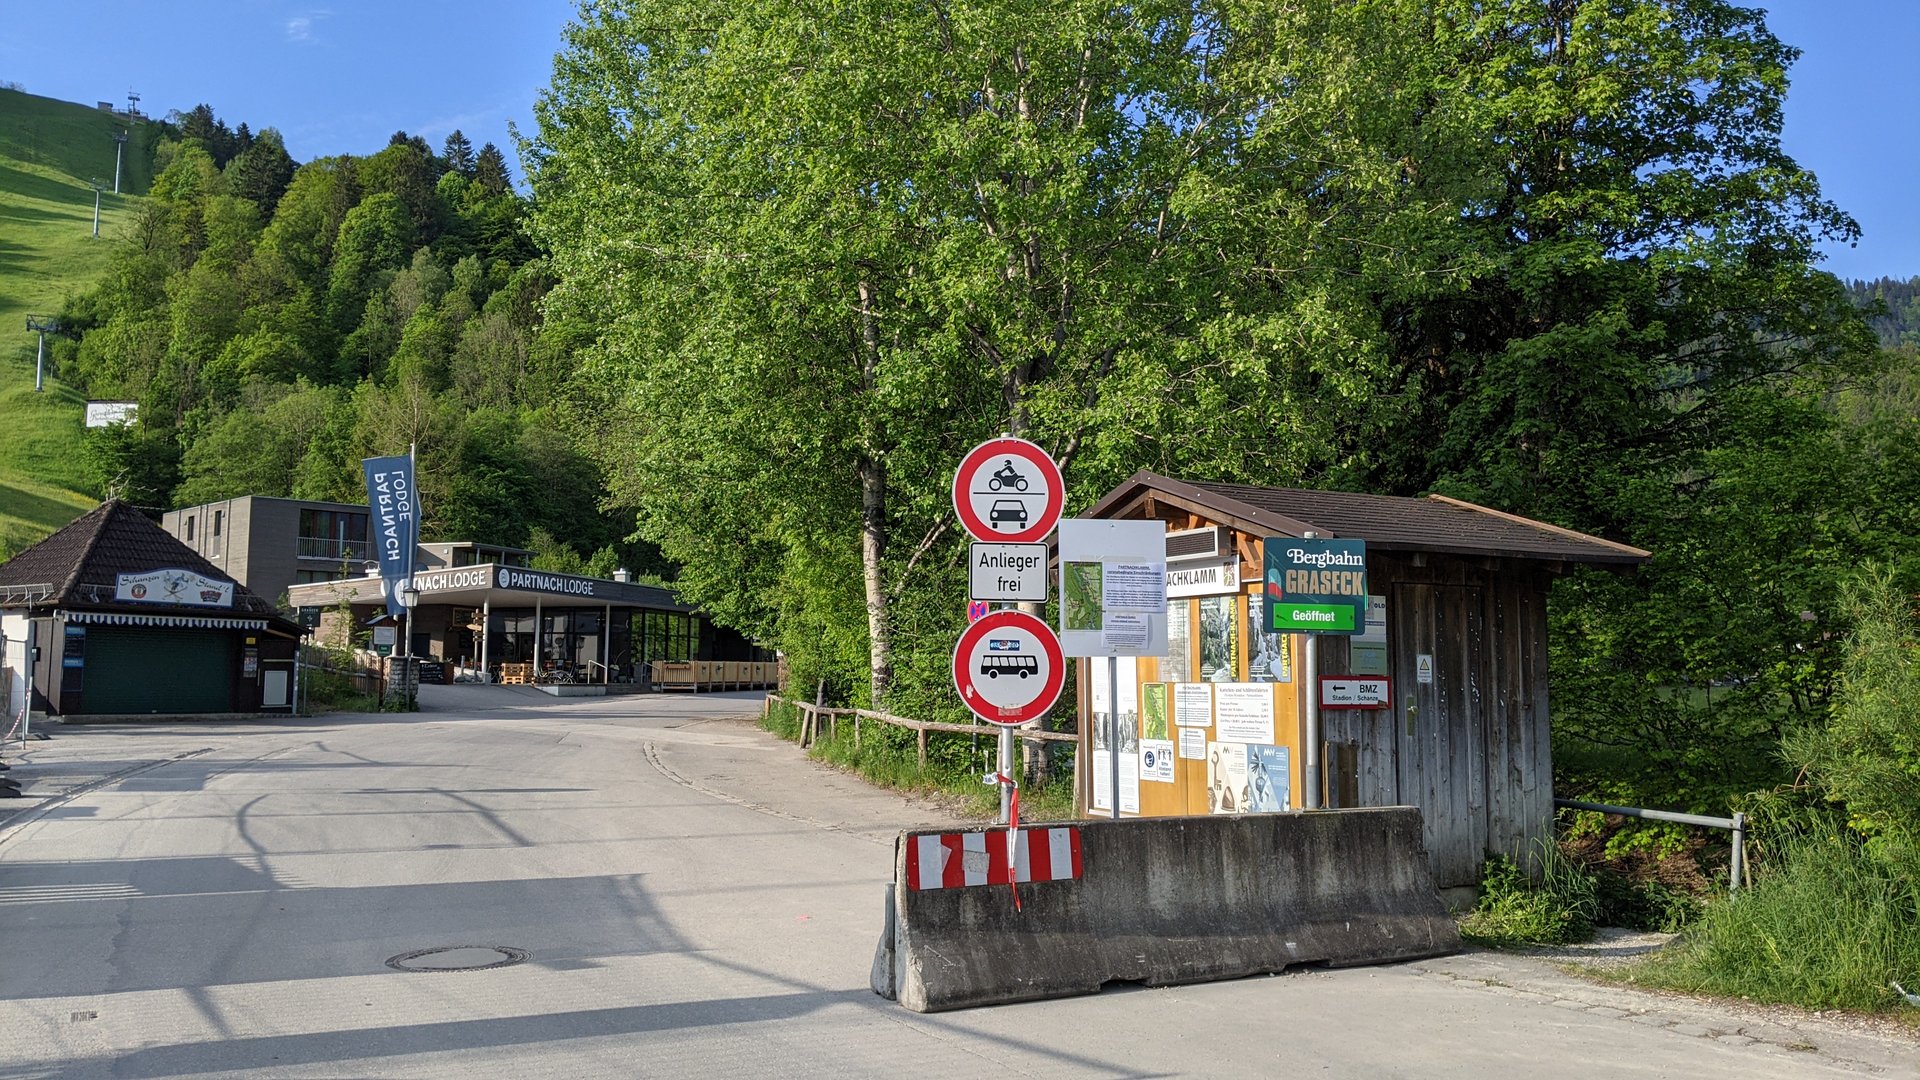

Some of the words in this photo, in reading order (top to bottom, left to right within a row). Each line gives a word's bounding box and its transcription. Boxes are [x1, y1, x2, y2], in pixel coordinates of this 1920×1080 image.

[979, 552, 1040, 572] Anlieger
[1286, 548, 1364, 568] Bergbahn
[998, 576, 1021, 592] frei
[1166, 569, 1217, 587] ACHKLAMM
[1285, 569, 1364, 596] GRASECK
[1292, 609, 1335, 622] Geöffnet
[1359, 684, 1378, 693] BMZ
